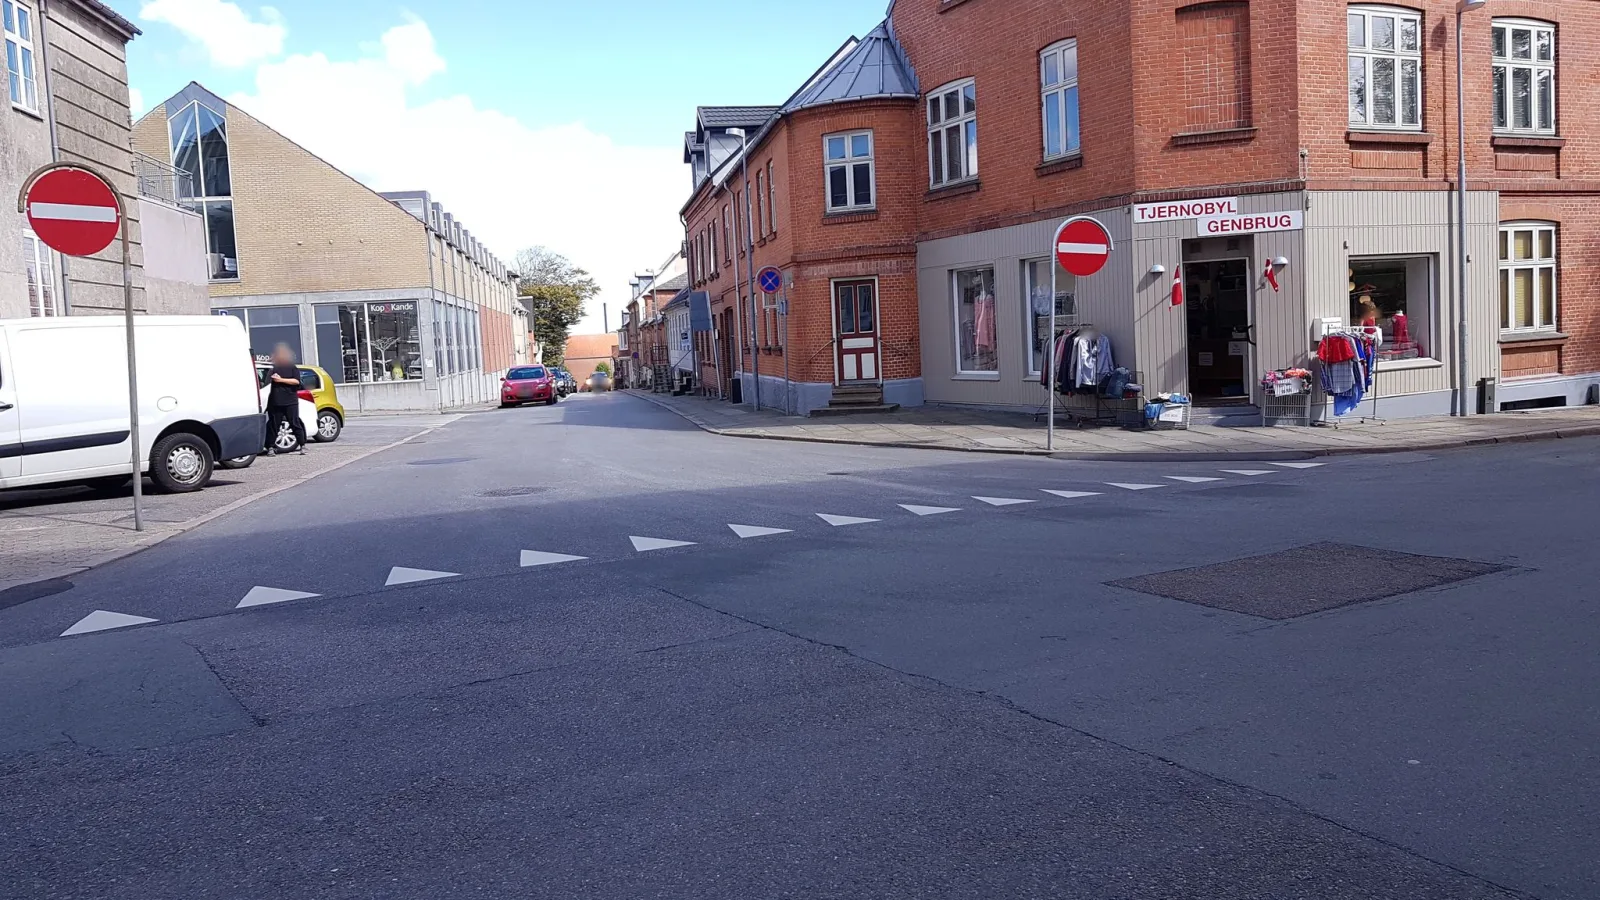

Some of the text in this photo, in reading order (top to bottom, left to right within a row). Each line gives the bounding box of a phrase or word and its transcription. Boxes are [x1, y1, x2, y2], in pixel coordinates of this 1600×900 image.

[1138, 201, 1237, 219] TJERNOBYL
[1207, 215, 1291, 233] GENBRUG
[391, 302, 414, 311] Kande
